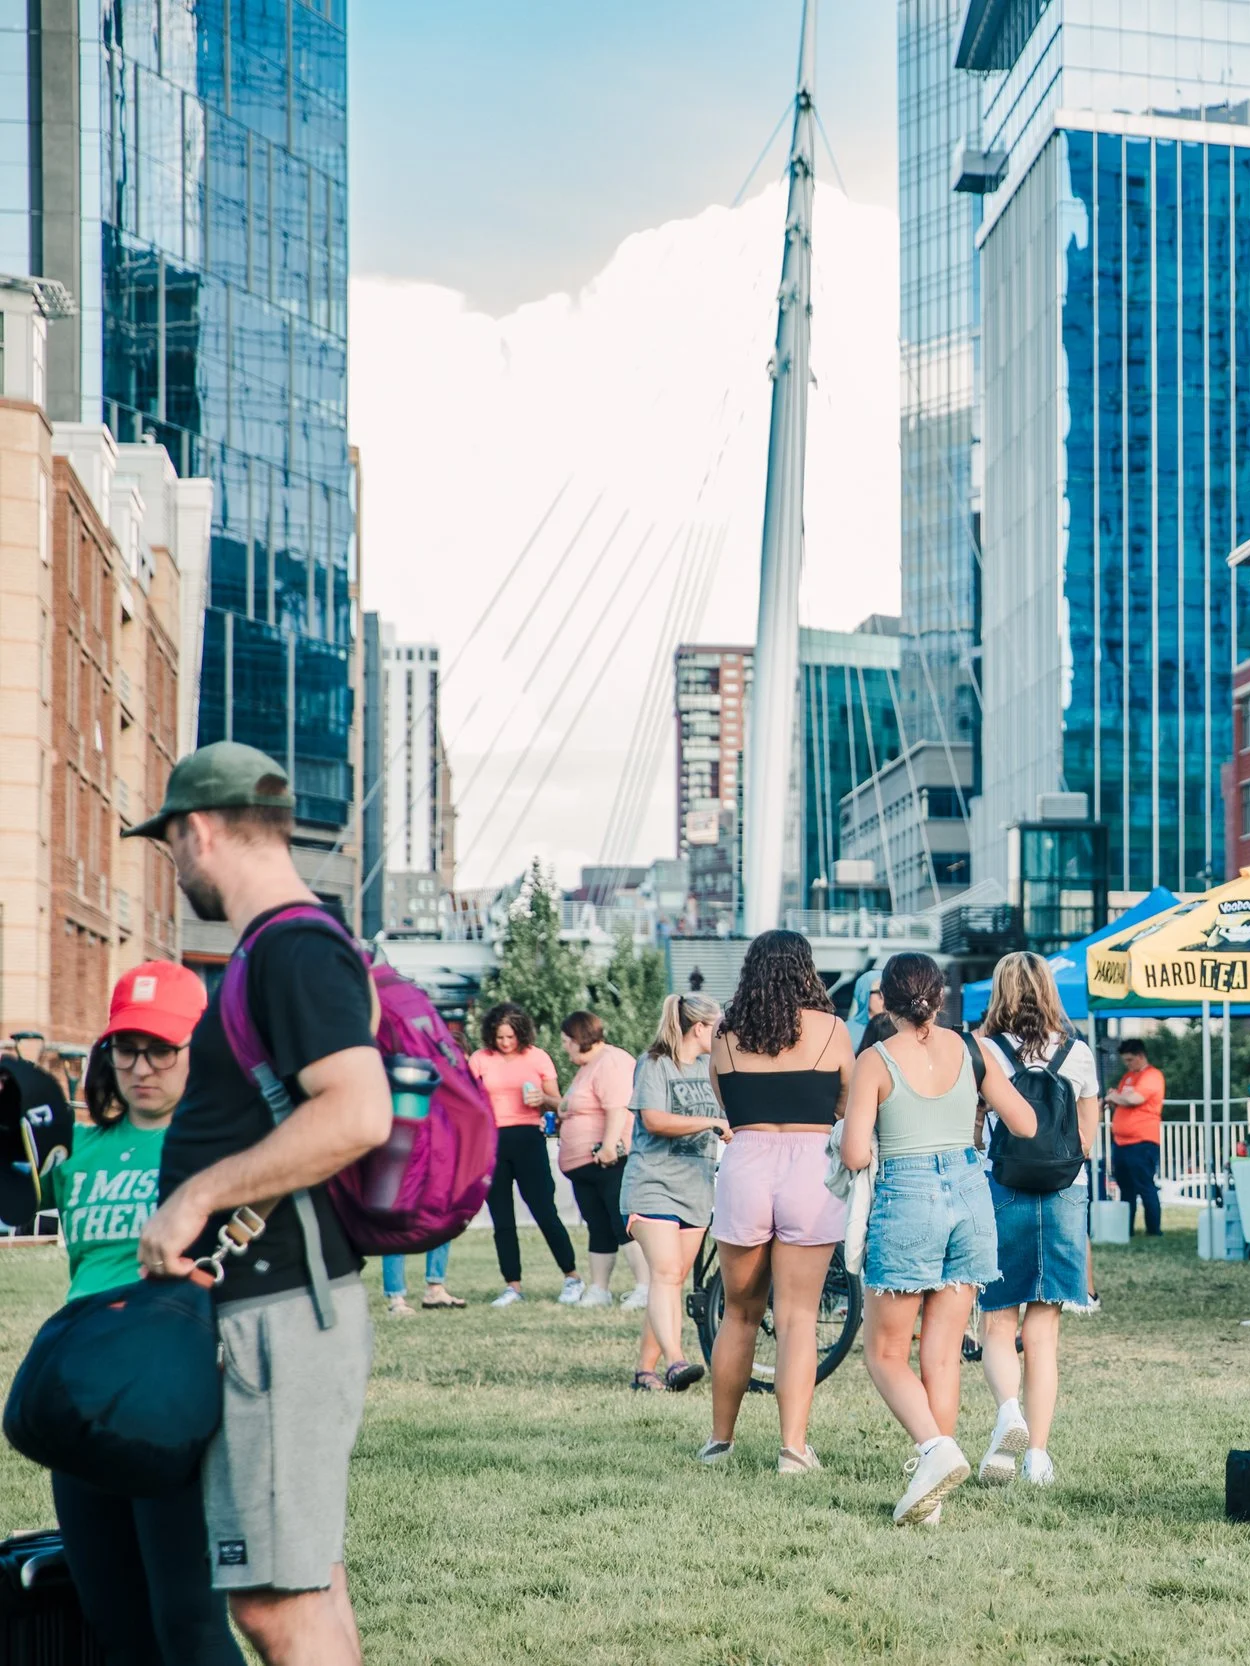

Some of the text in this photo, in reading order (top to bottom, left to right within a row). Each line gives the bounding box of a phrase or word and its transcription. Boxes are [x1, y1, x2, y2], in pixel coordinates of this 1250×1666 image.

[1145, 958, 1248, 993] HARD TEA
[673, 1082, 717, 1107] PHIS
[68, 1168, 159, 1207] I MIS
